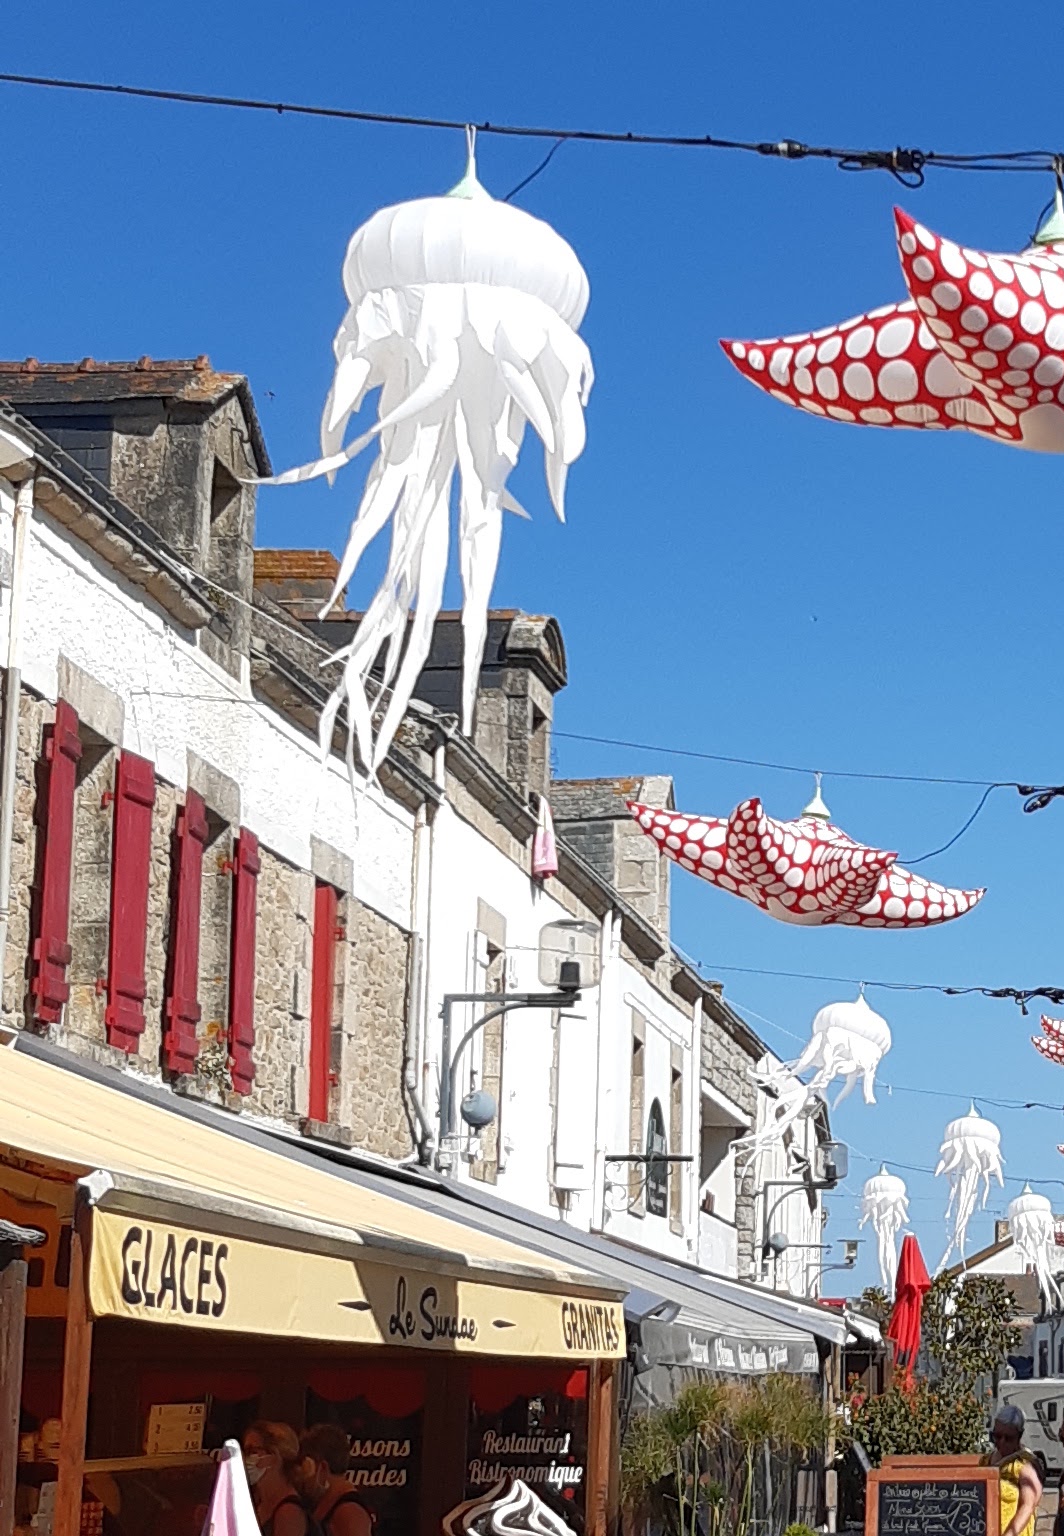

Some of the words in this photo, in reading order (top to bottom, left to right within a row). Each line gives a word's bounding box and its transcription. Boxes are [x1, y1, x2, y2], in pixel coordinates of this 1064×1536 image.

[121, 1226, 228, 1318] GLACES
[389, 1276, 416, 1340] Le
[561, 1300, 619, 1352] GRANITAS
[347, 1434, 410, 1457] ssons
[483, 1429, 571, 1454] Restaurant
[345, 1464, 407, 1486] andes
[468, 1459, 583, 1490] Bistronomique
